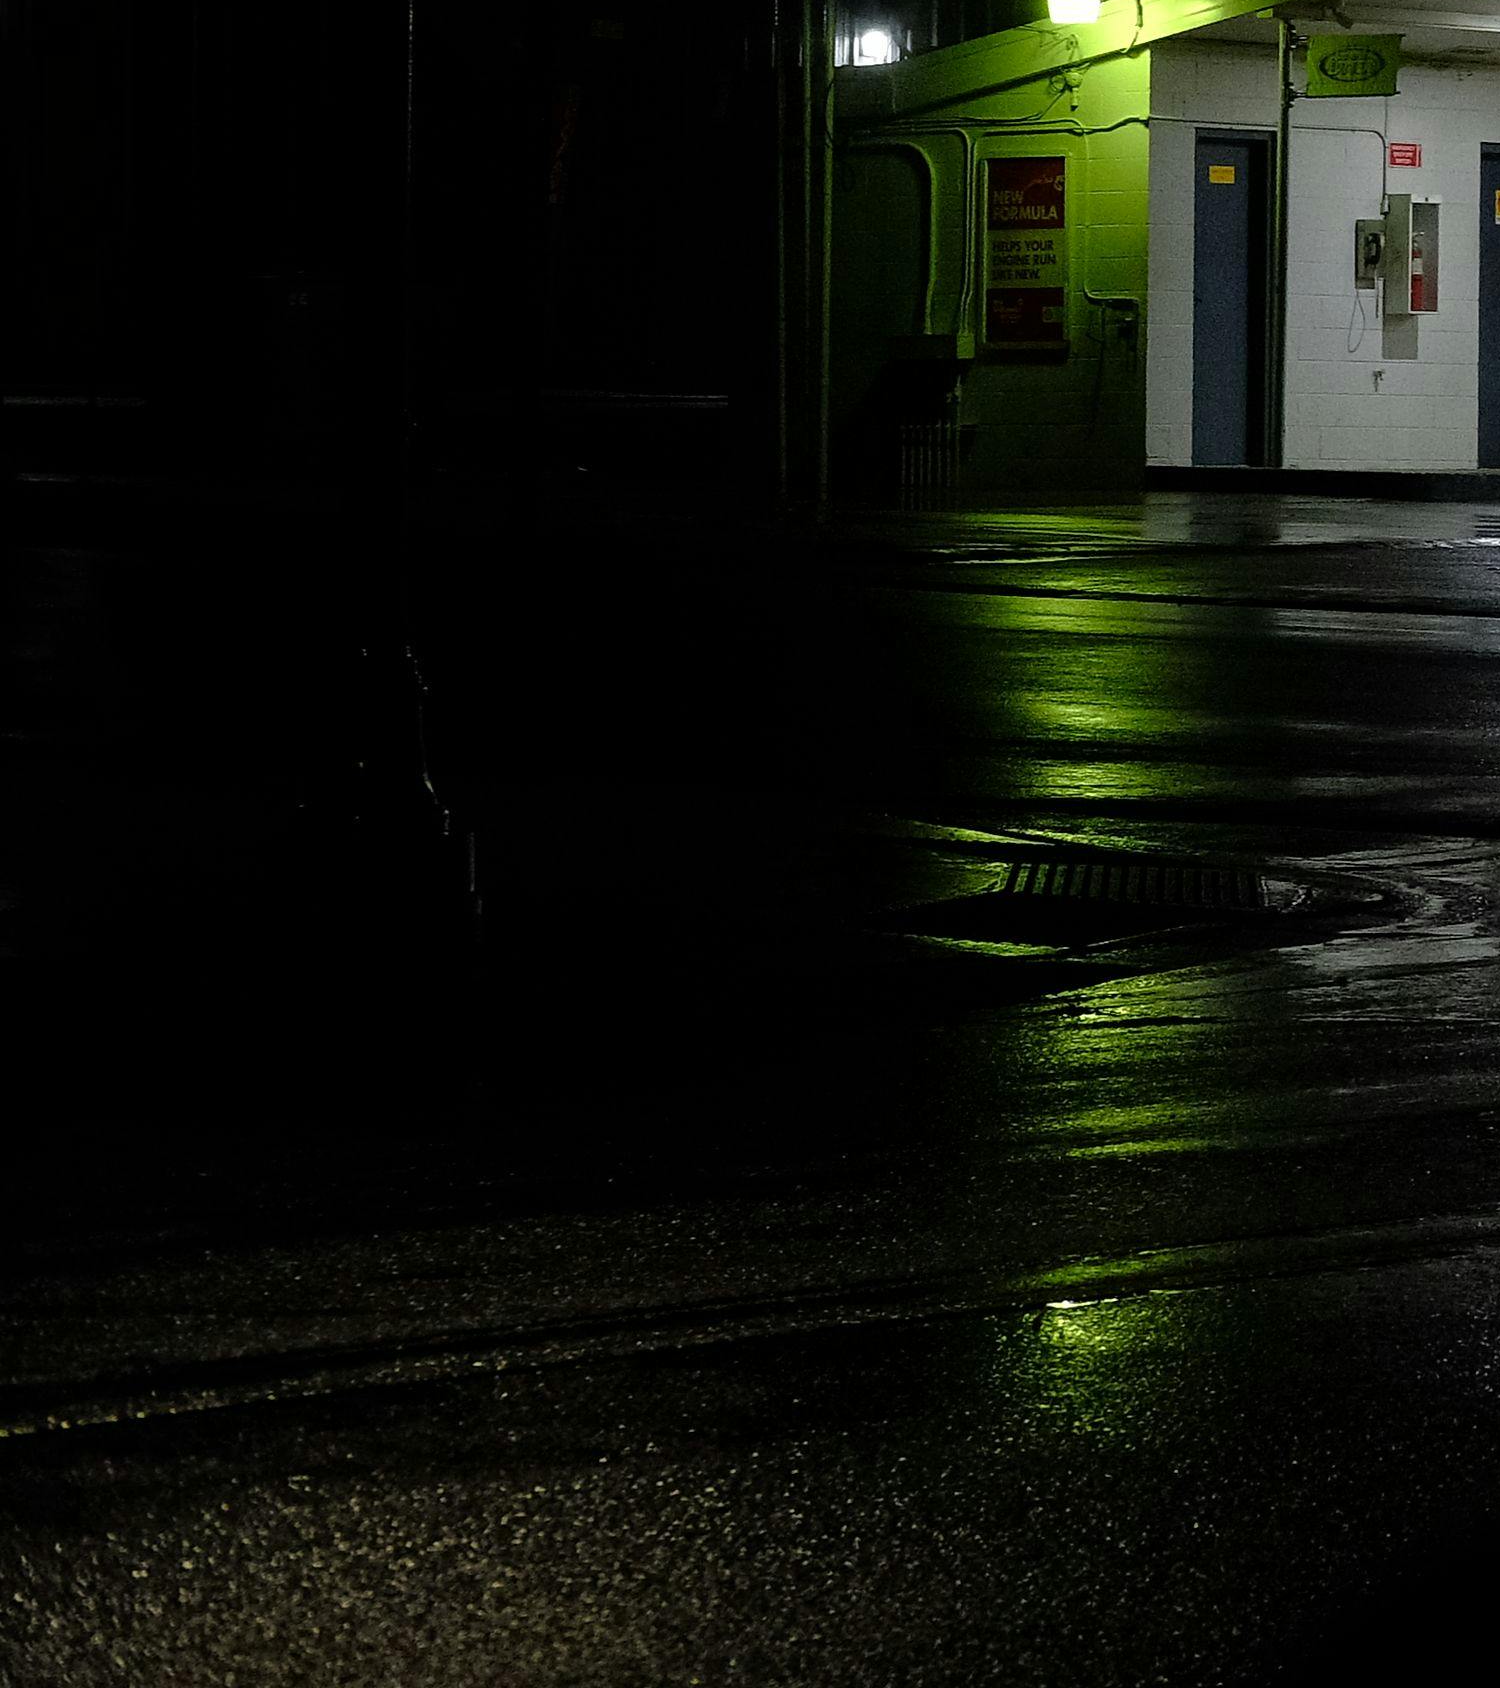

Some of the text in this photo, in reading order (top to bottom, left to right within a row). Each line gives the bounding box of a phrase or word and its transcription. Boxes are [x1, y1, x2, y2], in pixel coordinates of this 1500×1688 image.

[993, 190, 1024, 204] NEW
[992, 205, 1058, 221] FORMULA
[1024, 240, 1054, 252] YOUR
